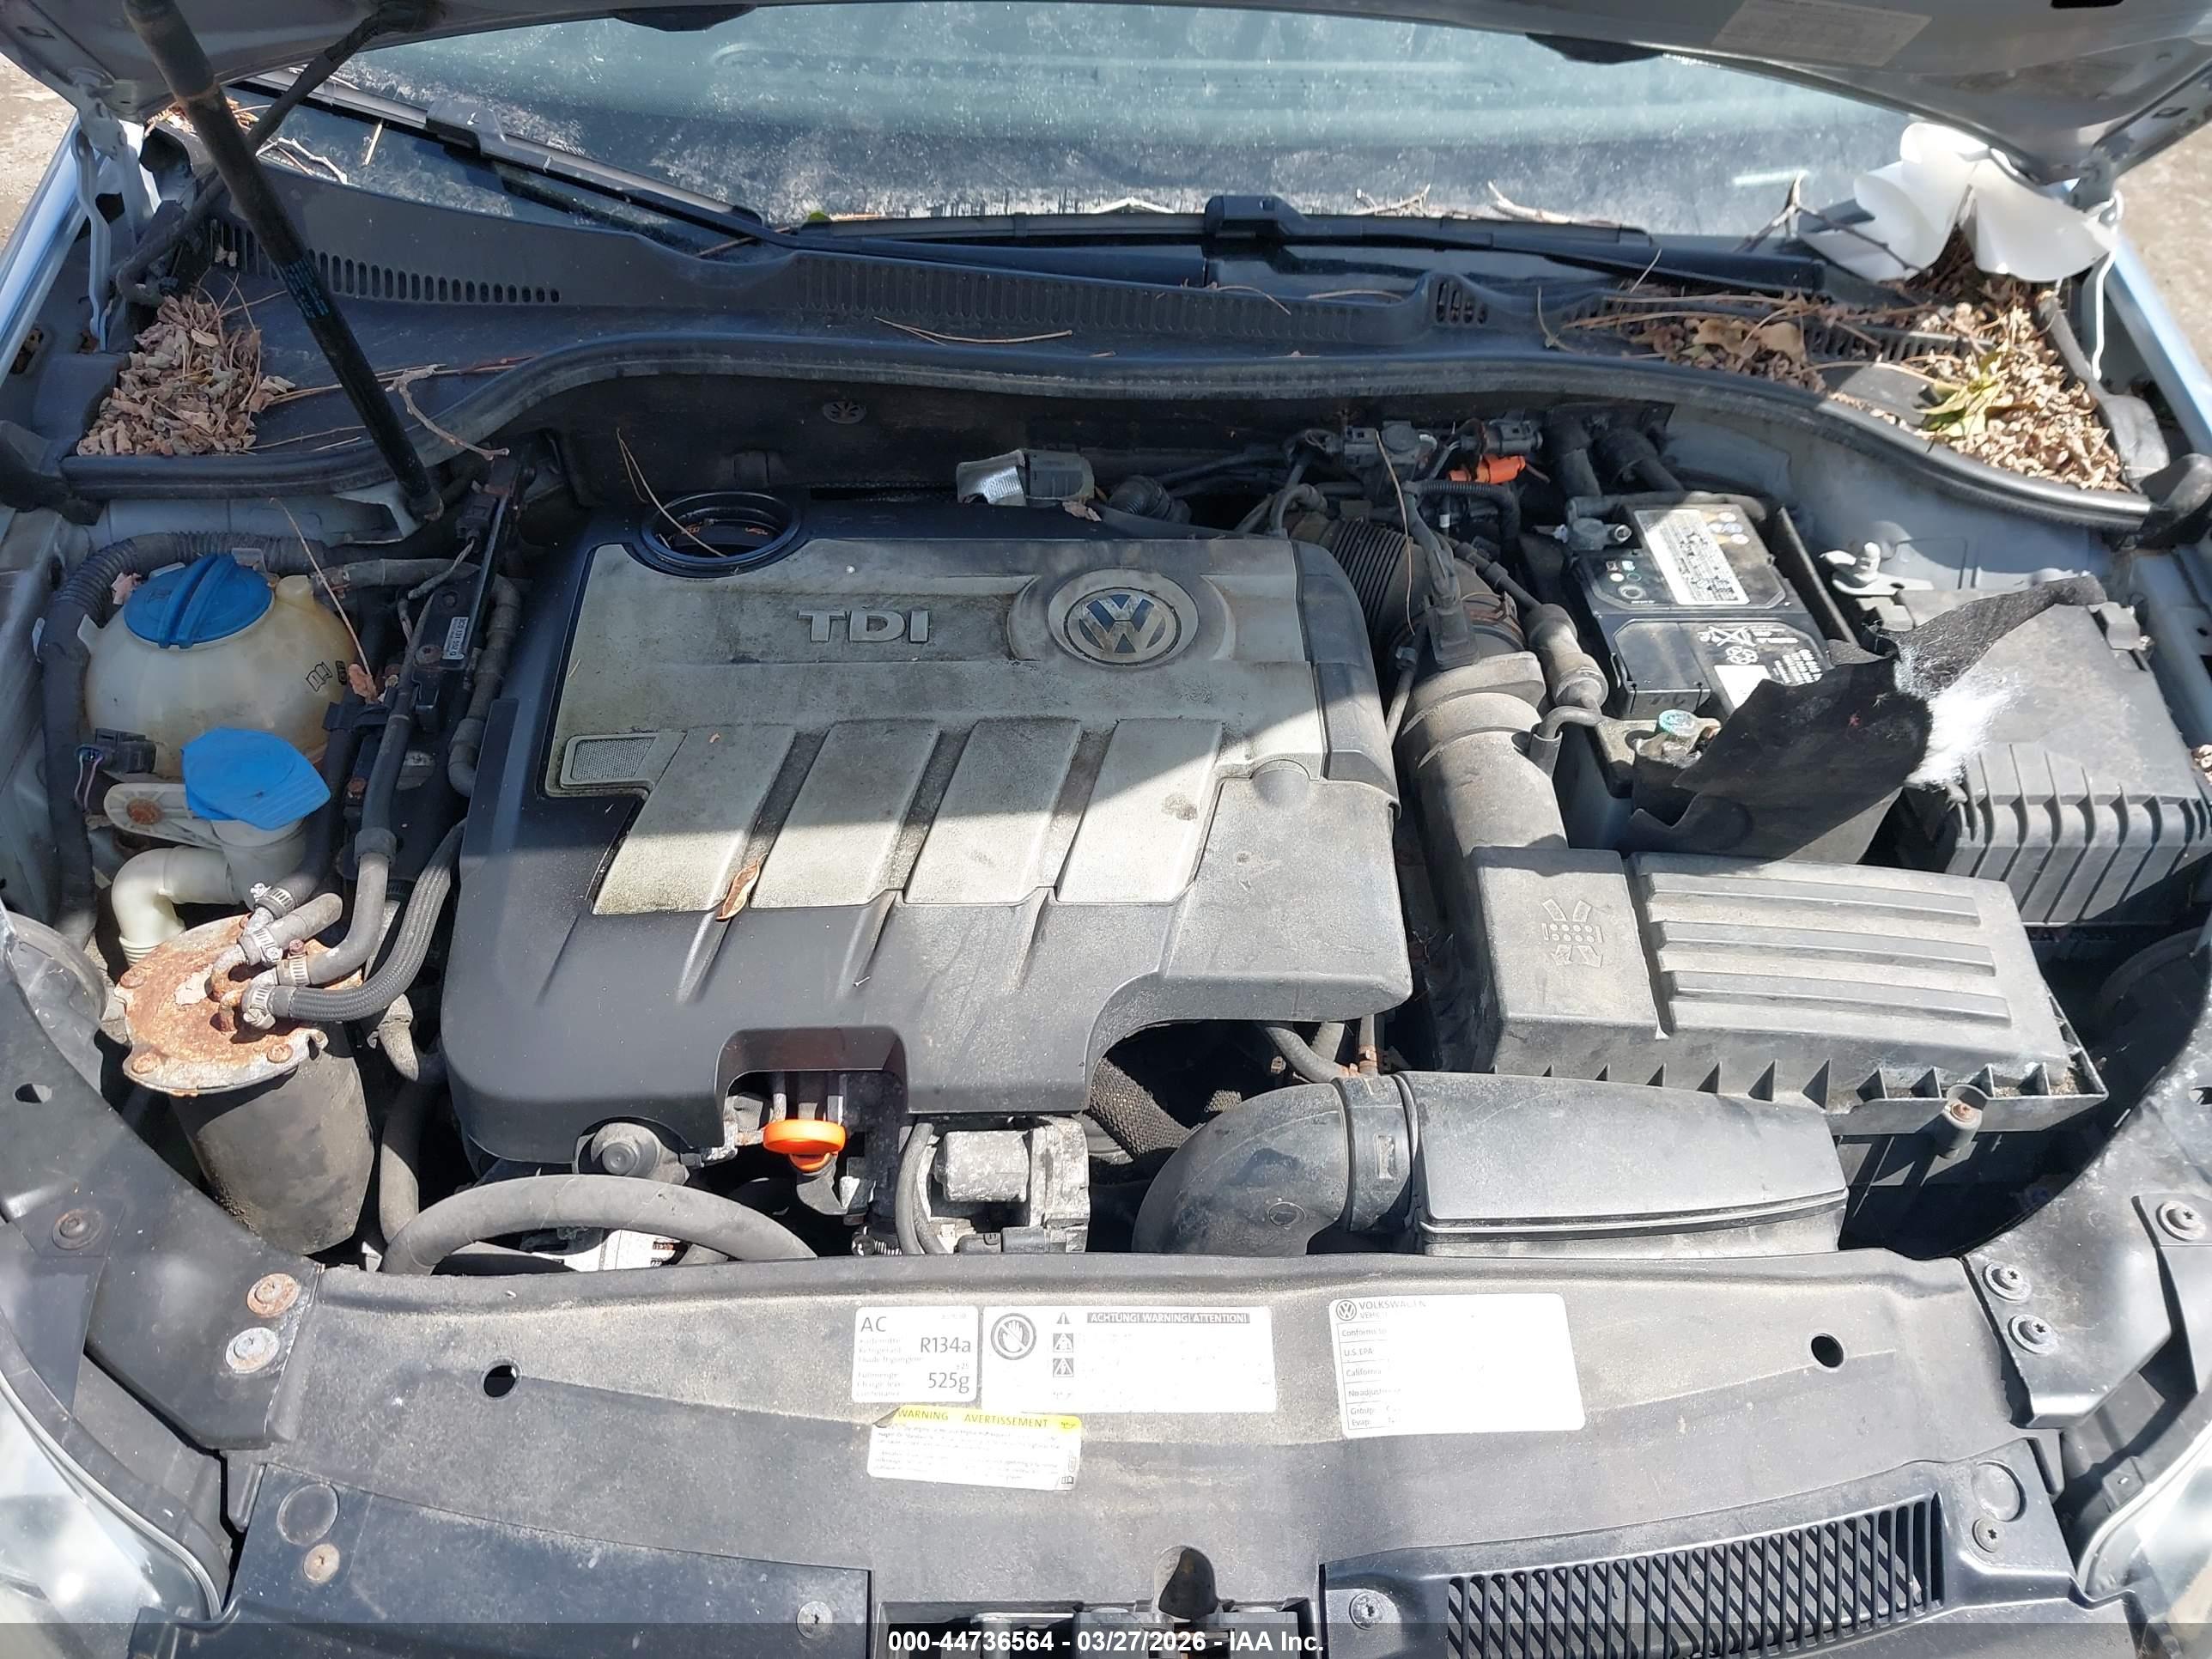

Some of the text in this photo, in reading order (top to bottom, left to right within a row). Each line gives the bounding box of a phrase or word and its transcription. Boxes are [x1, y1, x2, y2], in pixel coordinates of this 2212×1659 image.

[797, 609, 931, 643] TDI
[860, 1316, 887, 1333] AC
[1091, 1313, 1248, 1323] ACHTUNG! WARNING! ATTENTION!
[921, 1336, 971, 1353] R134a
[1359, 1346, 1374, 1356] EPA
[927, 1371, 970, 1395] 525g
[896, 1409, 949, 1421] WARNING
[963, 1413, 1048, 1428] AVERTISSEMENT
